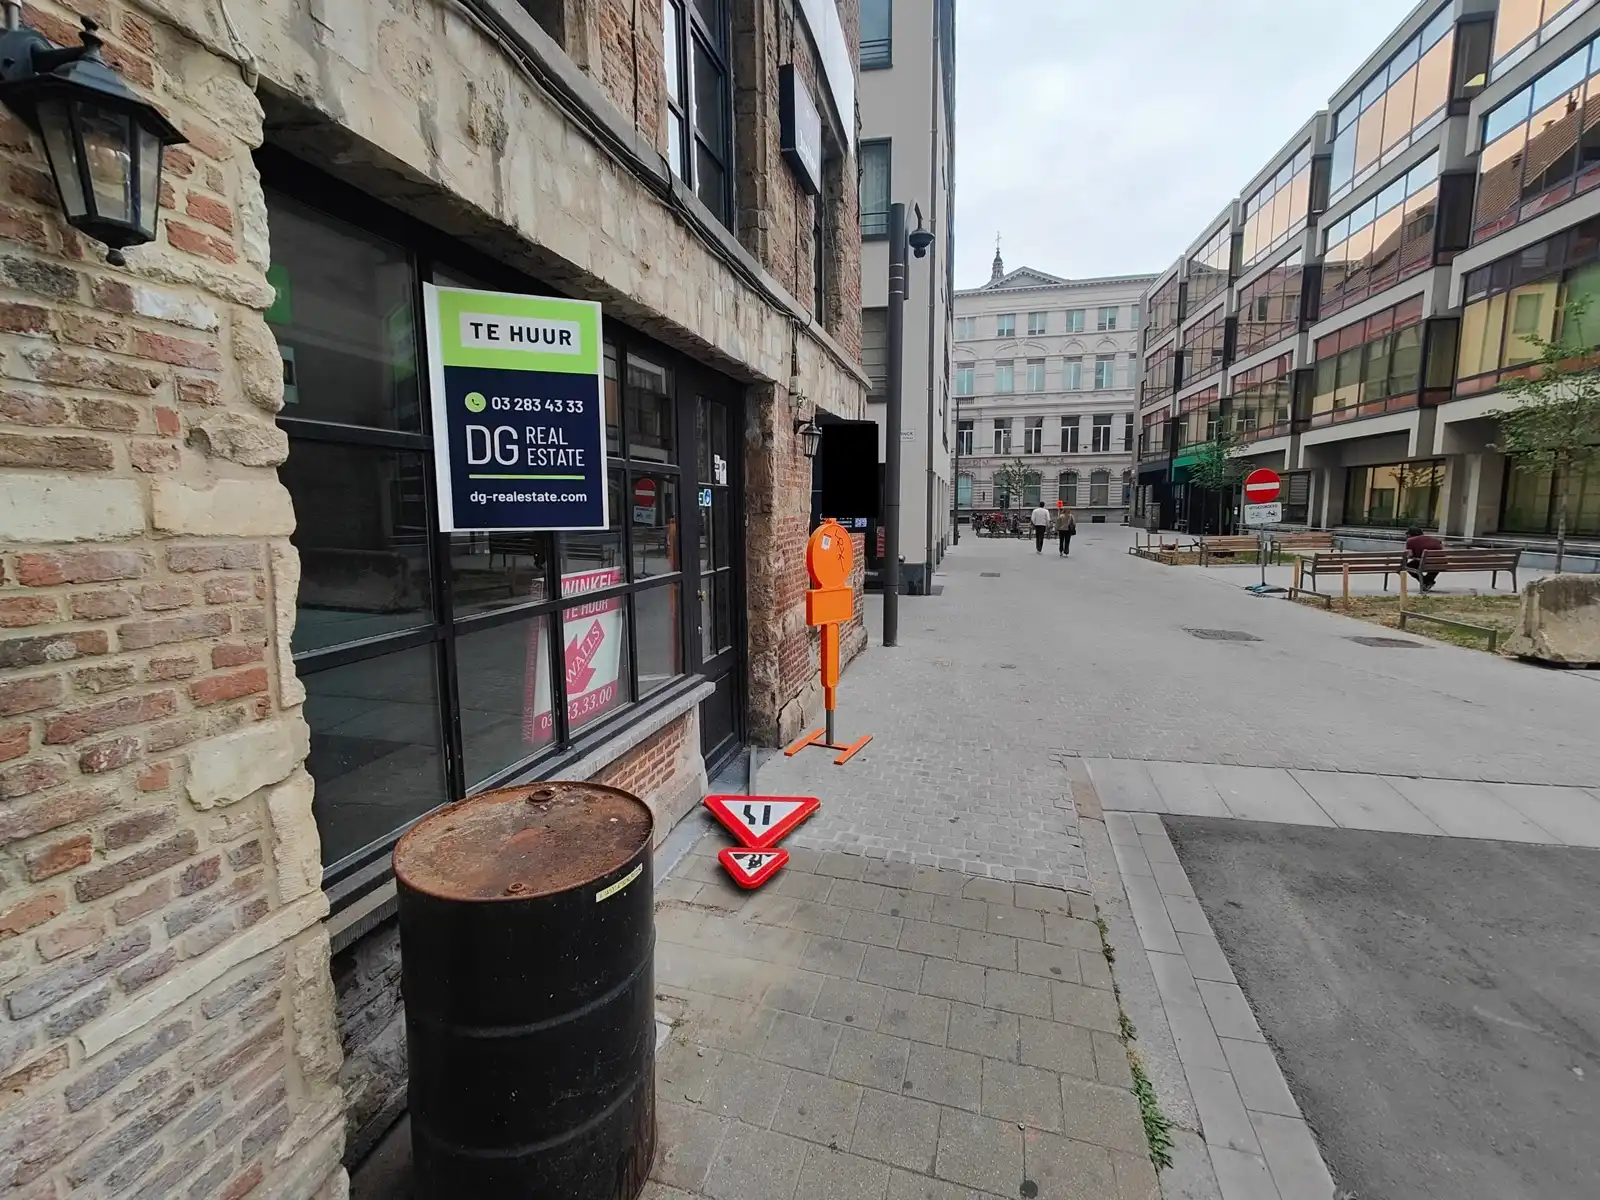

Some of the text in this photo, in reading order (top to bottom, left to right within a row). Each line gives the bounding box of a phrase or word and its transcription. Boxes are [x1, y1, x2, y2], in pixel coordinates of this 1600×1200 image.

[469, 322, 572, 346] TE HUUR
[491, 396, 584, 414] 03 283 43 33
[465, 424, 569, 467] DG REAL
[527, 448, 586, 467] ESTATE
[469, 491, 588, 505] dg-realestate.com
[566, 625, 601, 684] WALLS
